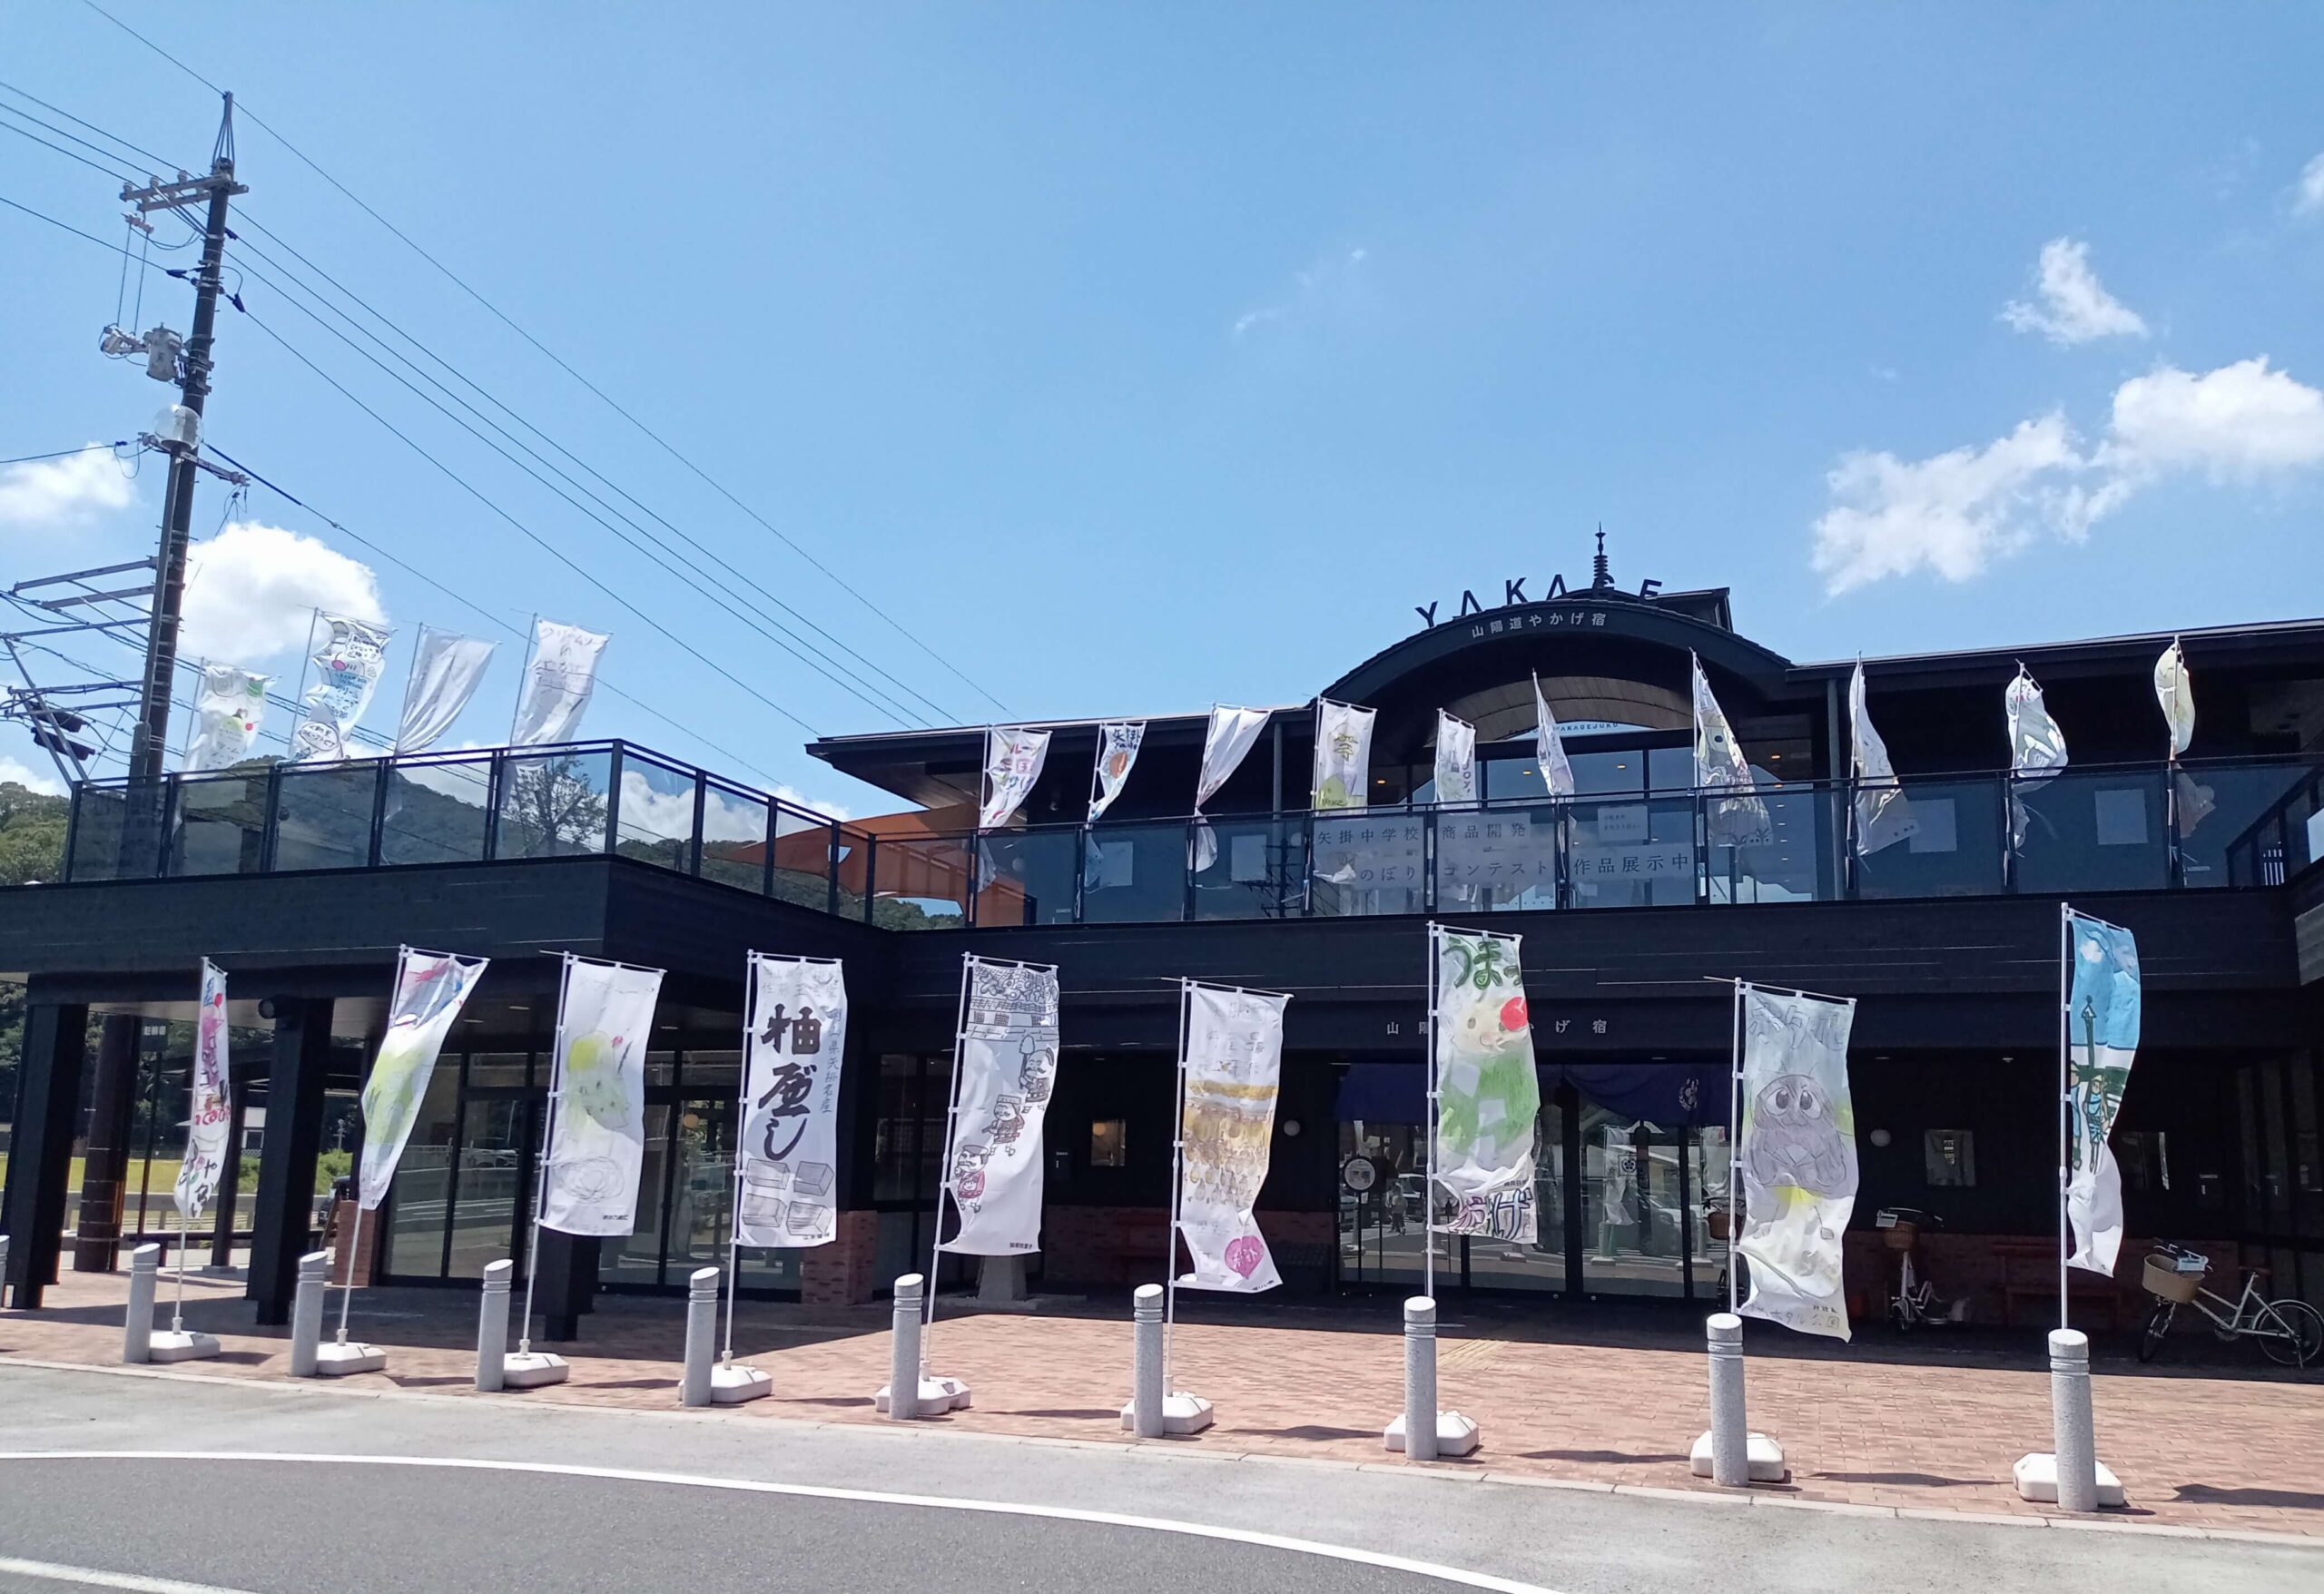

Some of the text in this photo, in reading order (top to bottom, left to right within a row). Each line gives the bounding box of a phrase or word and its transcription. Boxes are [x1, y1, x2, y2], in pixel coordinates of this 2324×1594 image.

[1472, 612, 1607, 638] 山陽道やかげ宿
[1318, 822, 1526, 845] 矢掛中学校 商品開発
[1362, 852, 1688, 881] のぼり コンテスト 作品展示中
